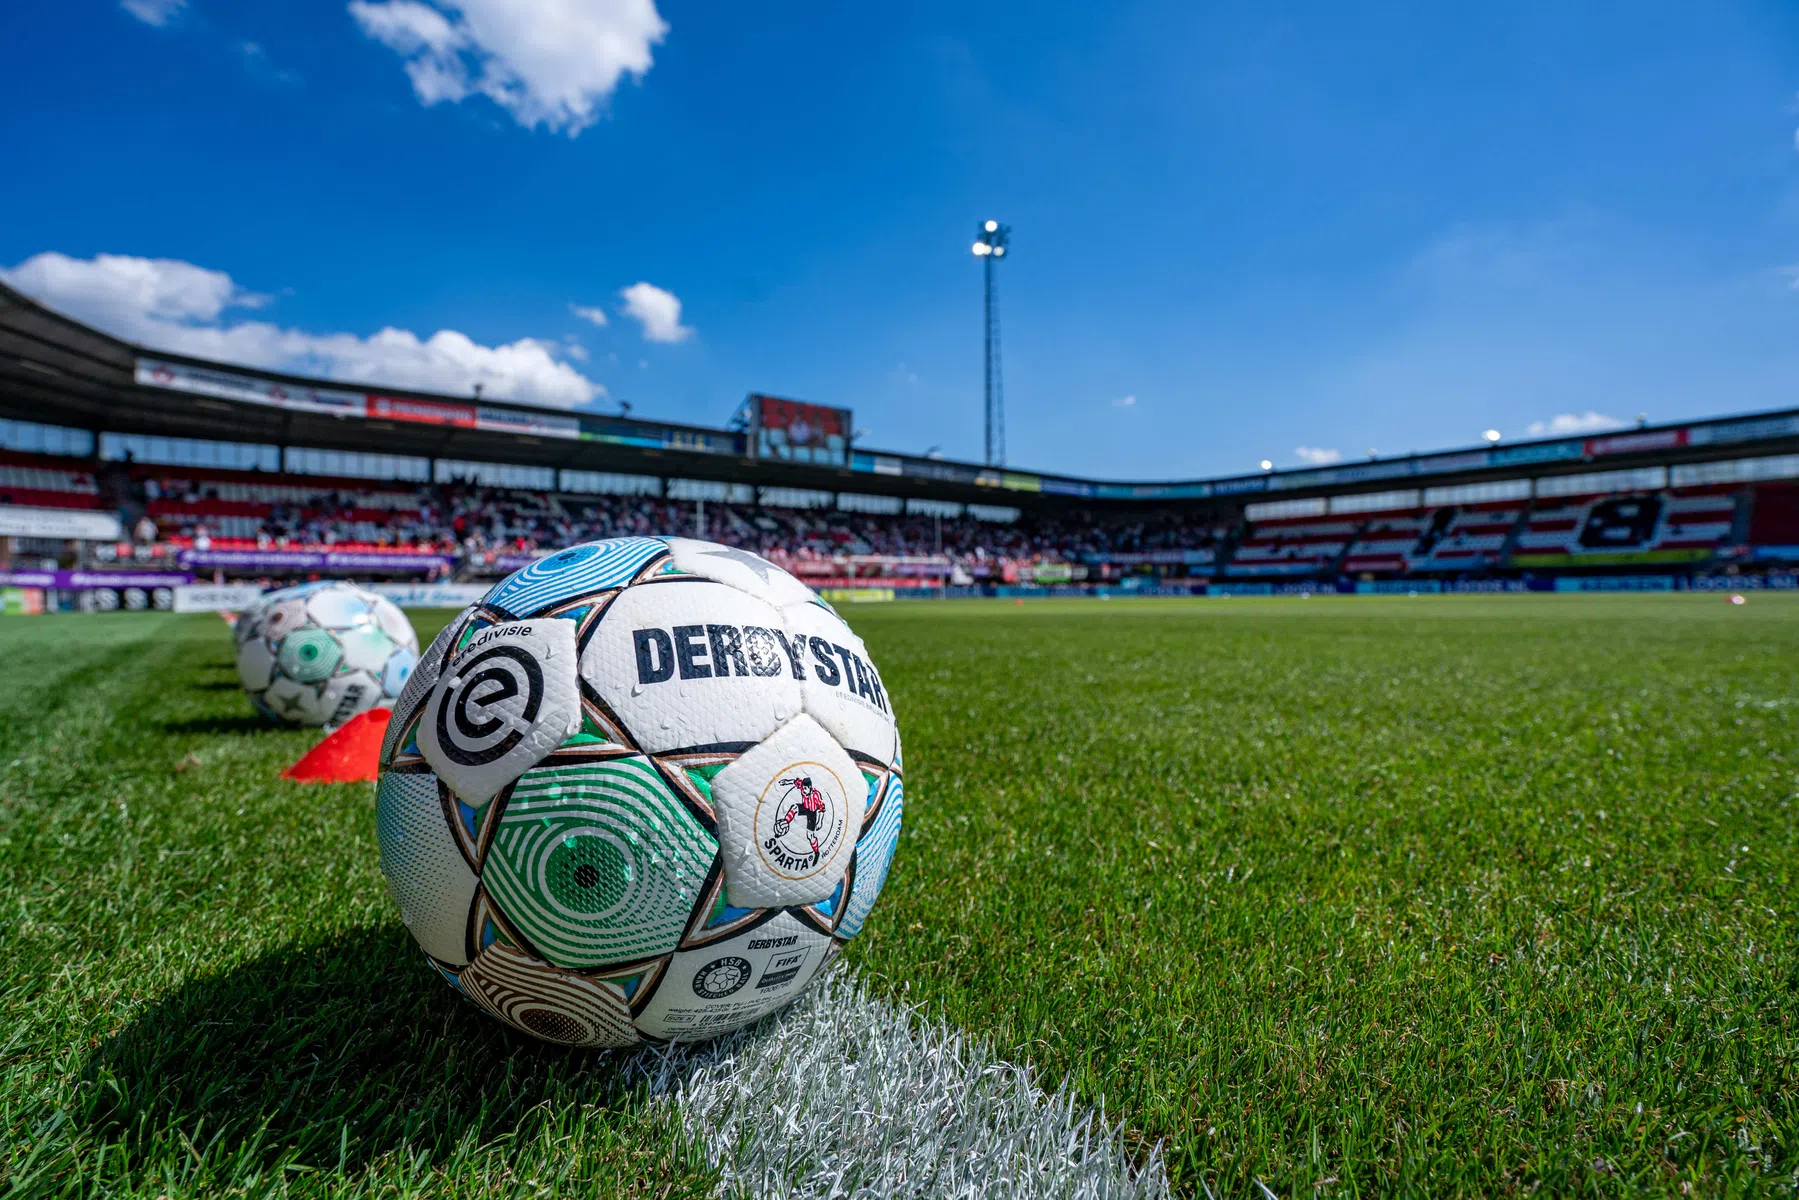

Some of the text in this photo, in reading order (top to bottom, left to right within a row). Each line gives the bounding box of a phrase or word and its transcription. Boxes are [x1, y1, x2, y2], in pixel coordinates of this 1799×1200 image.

[632, 624, 888, 714] DERBYSTAR
[821, 819, 843, 859] ROTTERDAM
[747, 935, 798, 950] DERBYSTAR
[720, 957, 743, 966] HSB
[775, 955, 799, 968] FIFA
